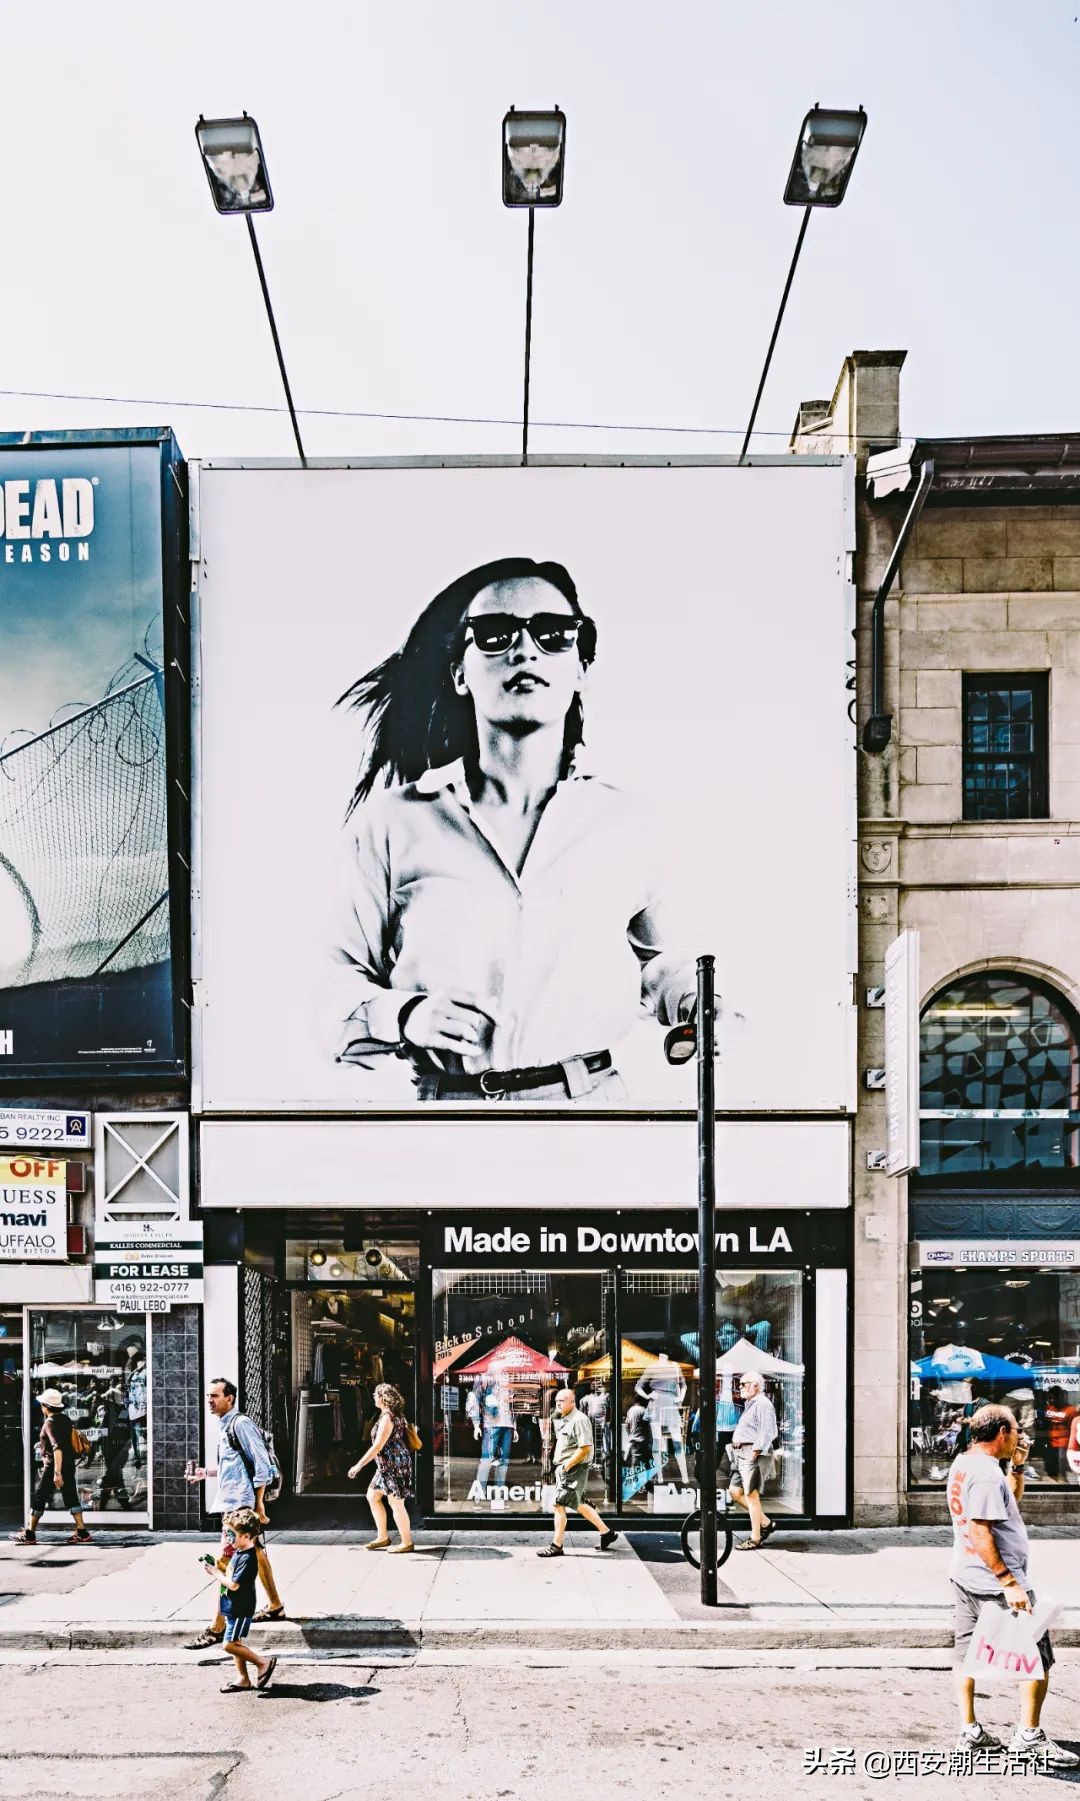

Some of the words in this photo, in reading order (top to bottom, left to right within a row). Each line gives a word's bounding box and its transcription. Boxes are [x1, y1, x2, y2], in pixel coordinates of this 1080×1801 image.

[0, 478, 95, 540] EAD
[17, 1113, 45, 1121] REALTY
[16, 1127, 64, 1141] 9222
[9, 1159, 60, 1178] OFF
[444, 1227, 531, 1253] Made
[540, 1227, 567, 1252] in
[749, 1227, 793, 1252] LA
[960, 1250, 1017, 1262] CHAMPS
[1021, 1250, 1074, 1262] SPORTS
[110, 1265, 139, 1277] FOR
[142, 1265, 189, 1277] LEASE
[110, 1283, 136, 1293] (416)
[140, 1283, 189, 1292] 922-0777
[120, 1300, 142, 1311] PAUL
[143, 1300, 167, 1311] LEBO
[435, 1334, 460, 1352] Back
[462, 1332, 472, 1341] to
[475, 1308, 534, 1338] School
[437, 1350, 452, 1361] 2015
[976, 1636, 1038, 1674] hmv
